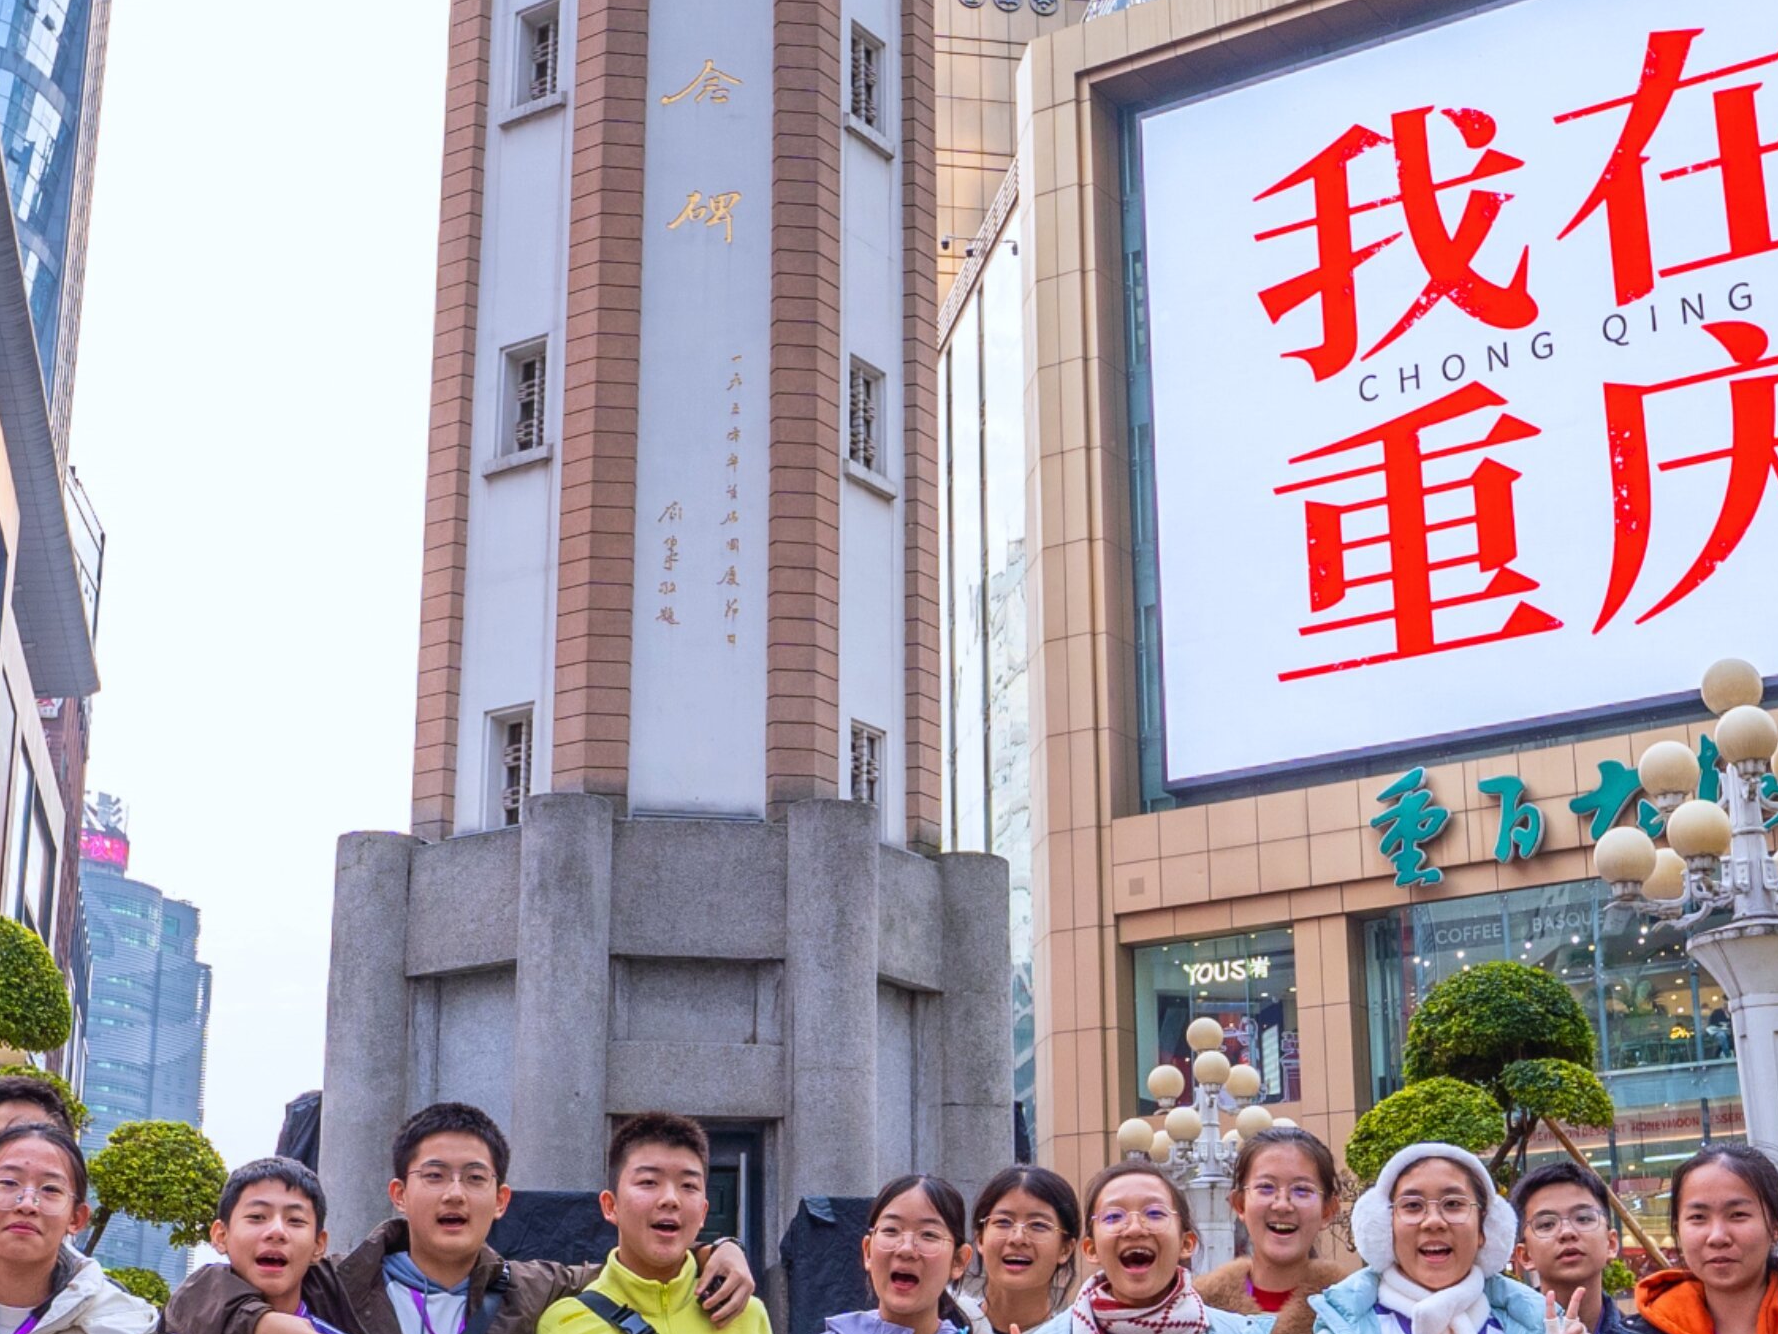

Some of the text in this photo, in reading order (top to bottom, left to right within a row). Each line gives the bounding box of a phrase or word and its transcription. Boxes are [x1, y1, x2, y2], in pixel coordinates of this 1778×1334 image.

[1357, 281, 1759, 405] CHONG QING
[1436, 922, 1502, 945] COFFEE
[1183, 959, 1246, 986] YOUS
